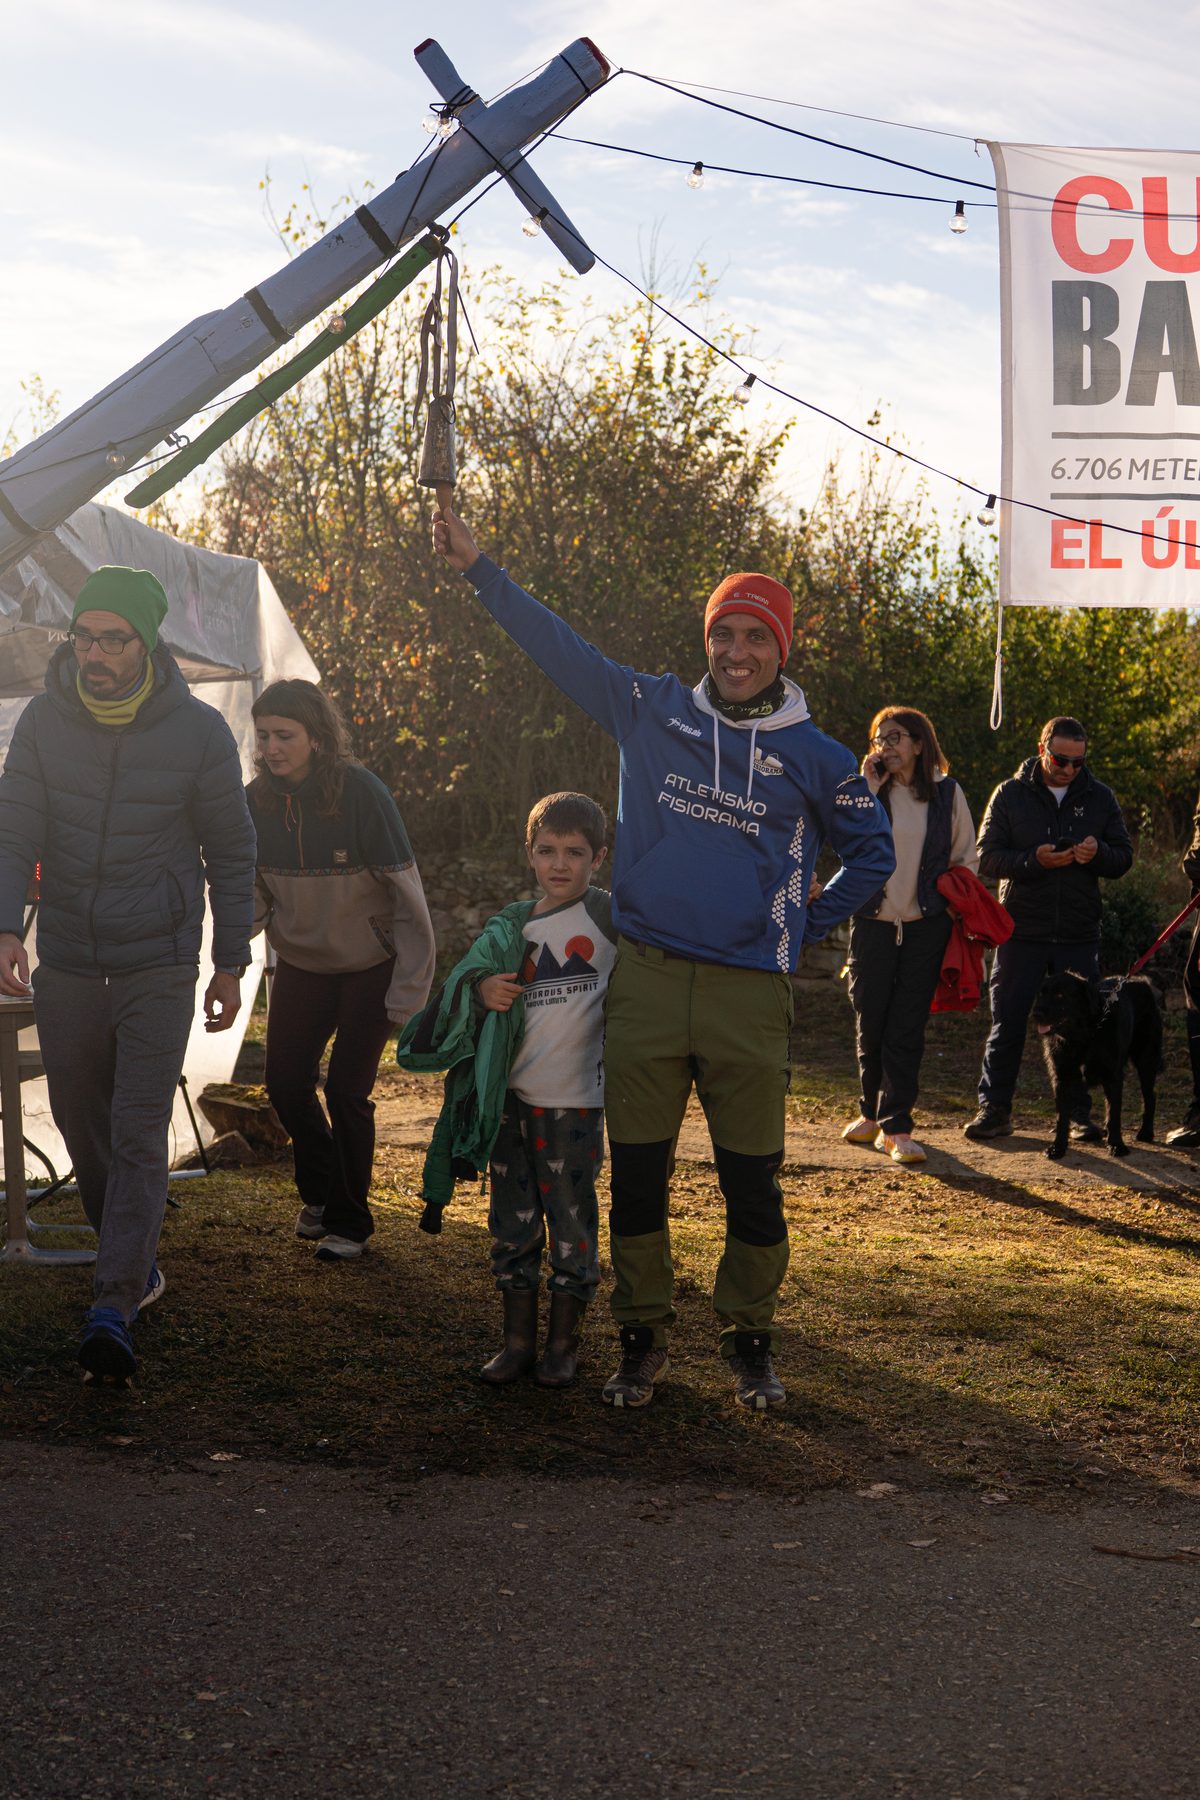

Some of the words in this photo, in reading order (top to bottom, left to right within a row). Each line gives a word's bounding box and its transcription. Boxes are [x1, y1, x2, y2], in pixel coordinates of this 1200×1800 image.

[1051, 280, 1200, 407] BA
[1050, 457, 1123, 480] 6.706
[1127, 457, 1200, 481] METE
[1050, 518, 1123, 569] EL
[657, 791, 760, 837] FISIORAMA
[664, 773, 767, 816] ATLETISMO
[566, 982, 598, 995] SPIRIT
